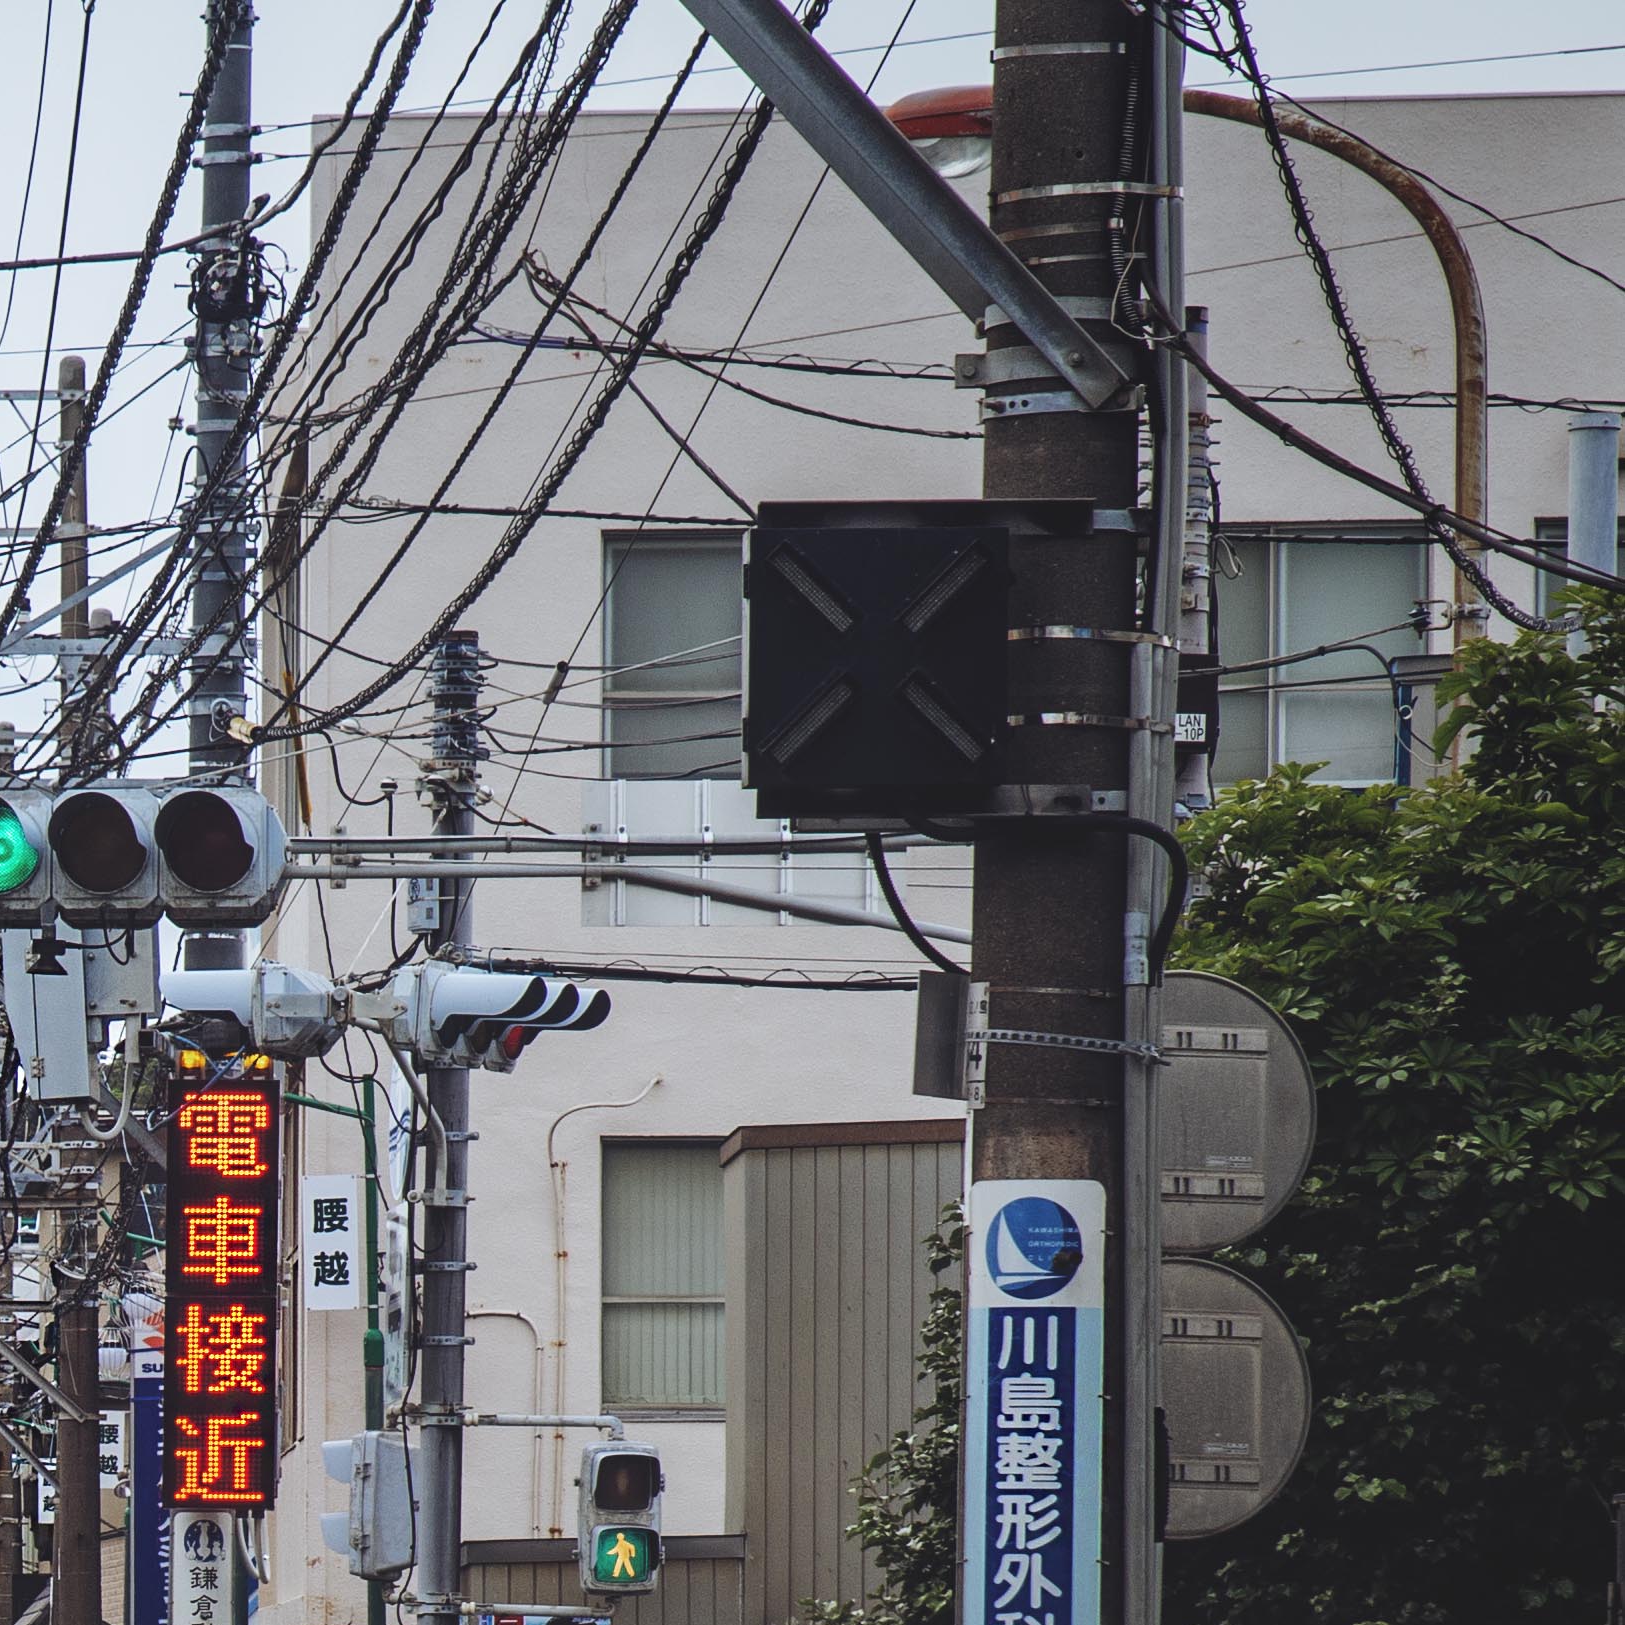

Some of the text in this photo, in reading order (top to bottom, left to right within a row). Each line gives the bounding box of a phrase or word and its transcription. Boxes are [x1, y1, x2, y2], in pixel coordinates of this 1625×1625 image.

[1178, 714, 1202, 727] LAN
[312, 1197, 350, 1288] 腰越
[173, 1092, 271, 1502] 電車接近
